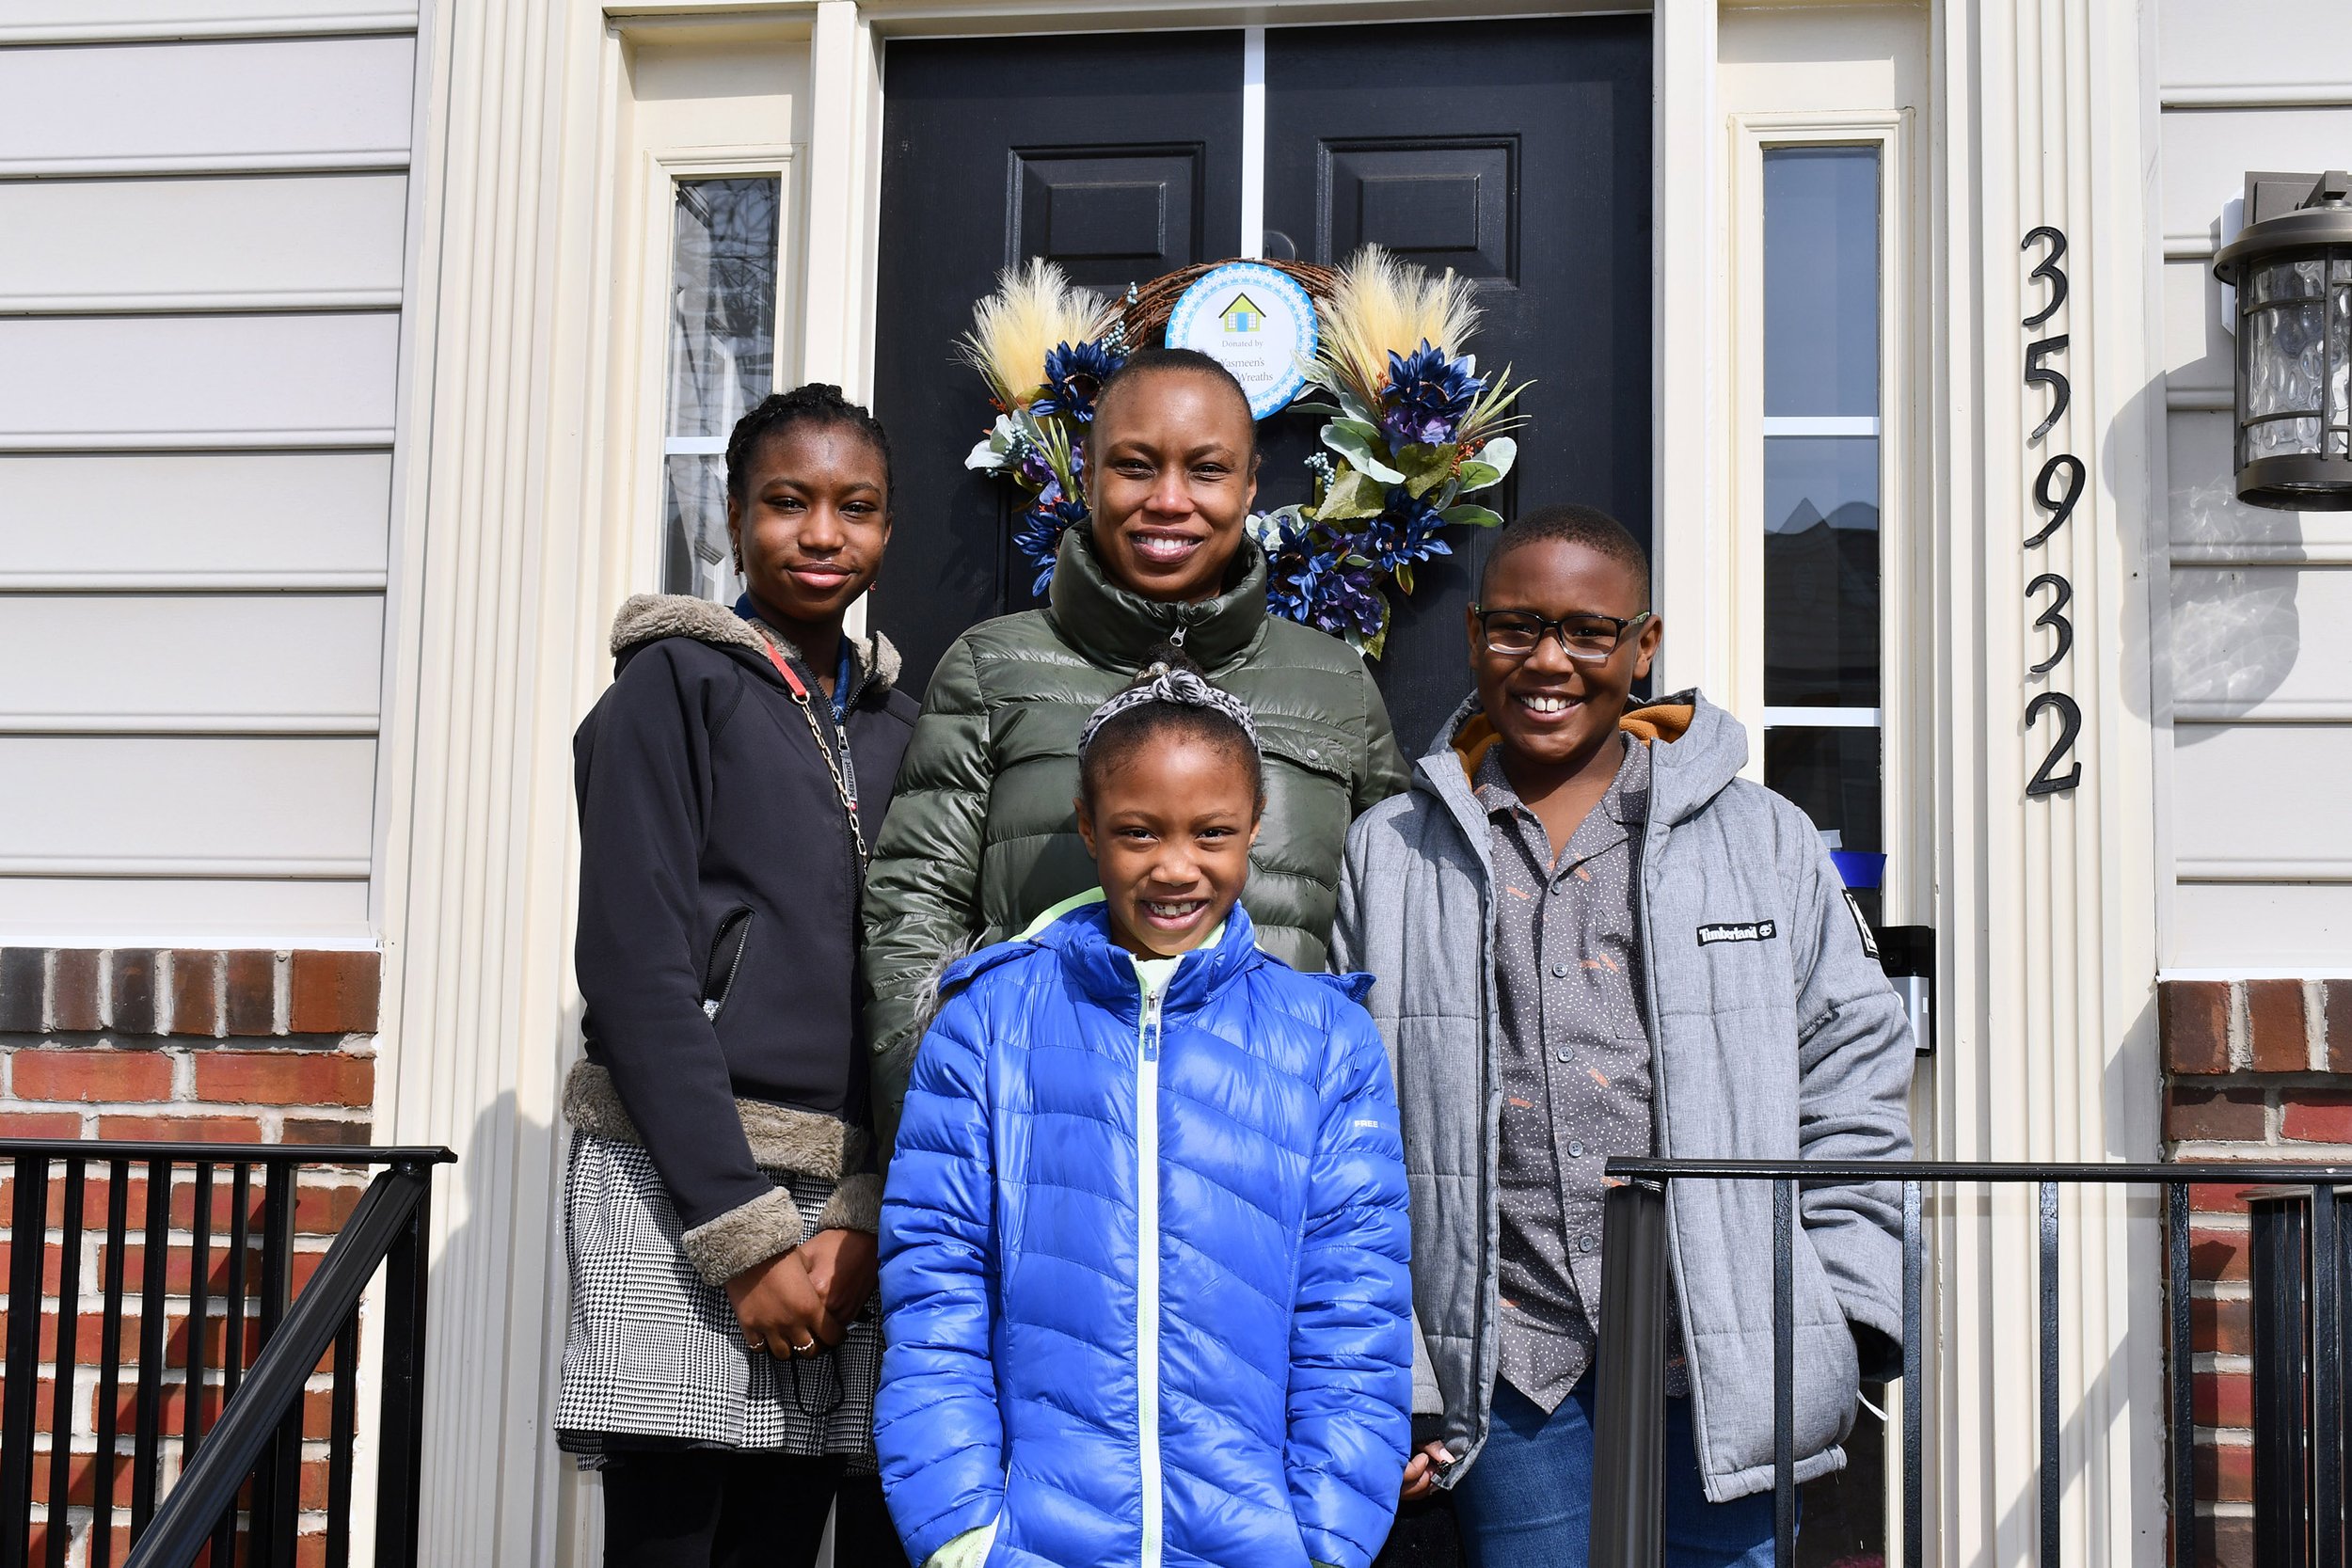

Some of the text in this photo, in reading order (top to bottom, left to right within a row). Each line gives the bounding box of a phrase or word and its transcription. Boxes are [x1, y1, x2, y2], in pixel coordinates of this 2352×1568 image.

[1255, 340, 1263, 348] by
[1220, 357, 1265, 368] Yasmeen's
[1236, 372, 1274, 382] Wreaths
[2022, 226, 2086, 797] 35932
[845, 761, 856, 798] Marmot
[1699, 927, 1758, 942] Timberland
